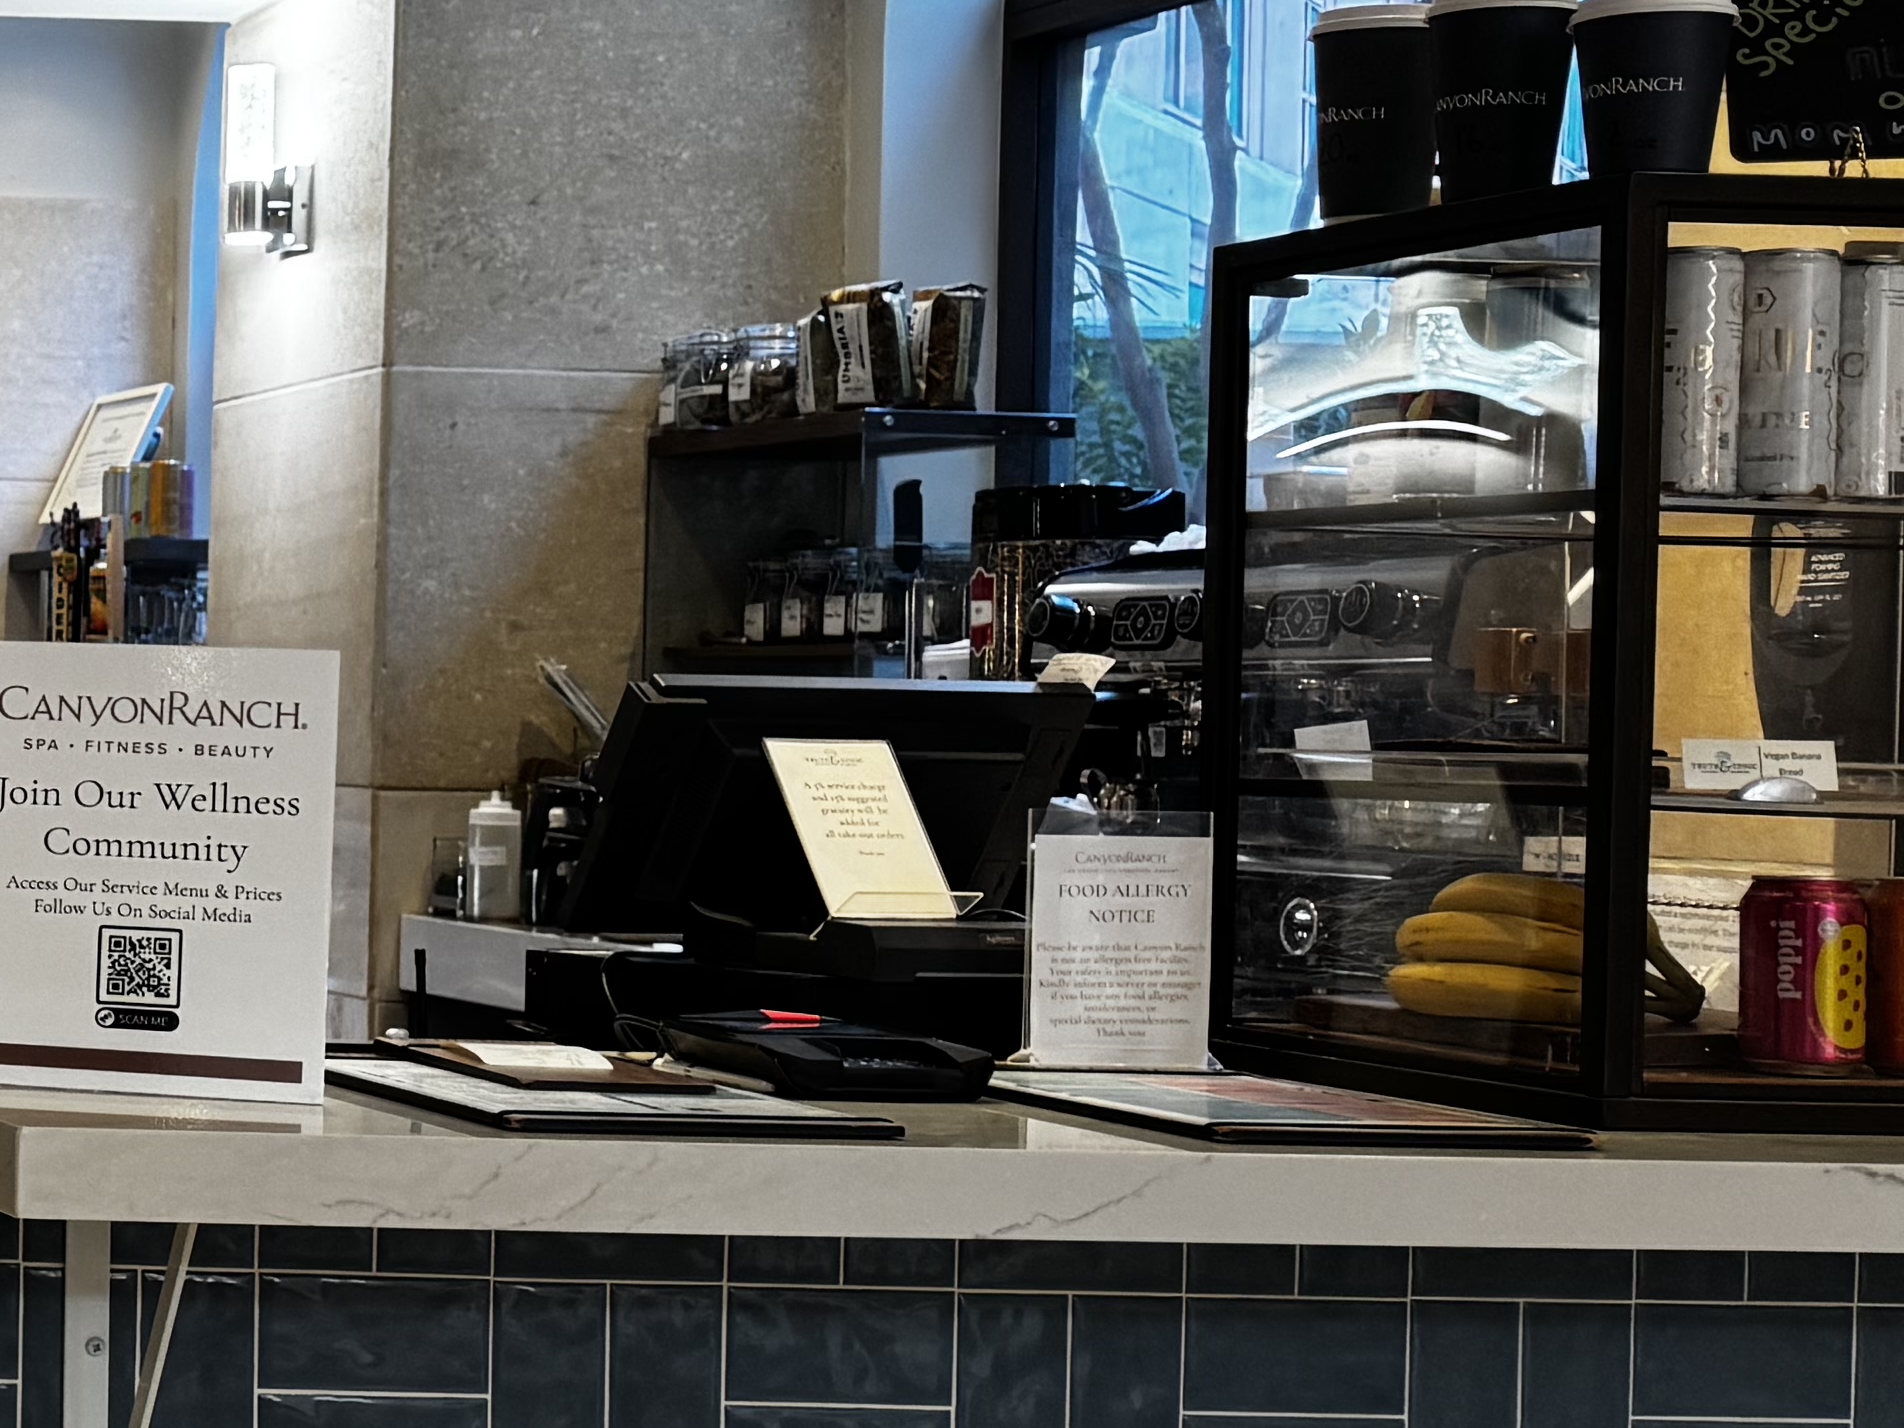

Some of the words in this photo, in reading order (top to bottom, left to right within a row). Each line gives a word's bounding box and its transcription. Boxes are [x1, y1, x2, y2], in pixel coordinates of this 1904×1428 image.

[23, 738, 58, 750] SPA
[85, 740, 166, 754] FITNESS
[194, 744, 273, 758] BEAUTY
[74, 780, 141, 808] Our
[153, 781, 299, 816] Wellness
[44, 827, 248, 873] Community
[6, 875, 57, 890] Access
[63, 877, 96, 892] Our
[101, 878, 157, 895] Service
[163, 881, 208, 897] Menu
[214, 884, 228, 898] &
[234, 885, 281, 901] Prices
[1058, 883, 1108, 898] FOOD
[1112, 883, 1191, 898] ALLERGY
[34, 898, 86, 914] Follow
[92, 901, 111, 916] Us
[117, 902, 142, 917] On
[148, 904, 195, 920] Social
[201, 906, 251, 923] Media
[1089, 909, 1154, 923] NOTICE
[1770, 920, 1803, 1000] poppi
